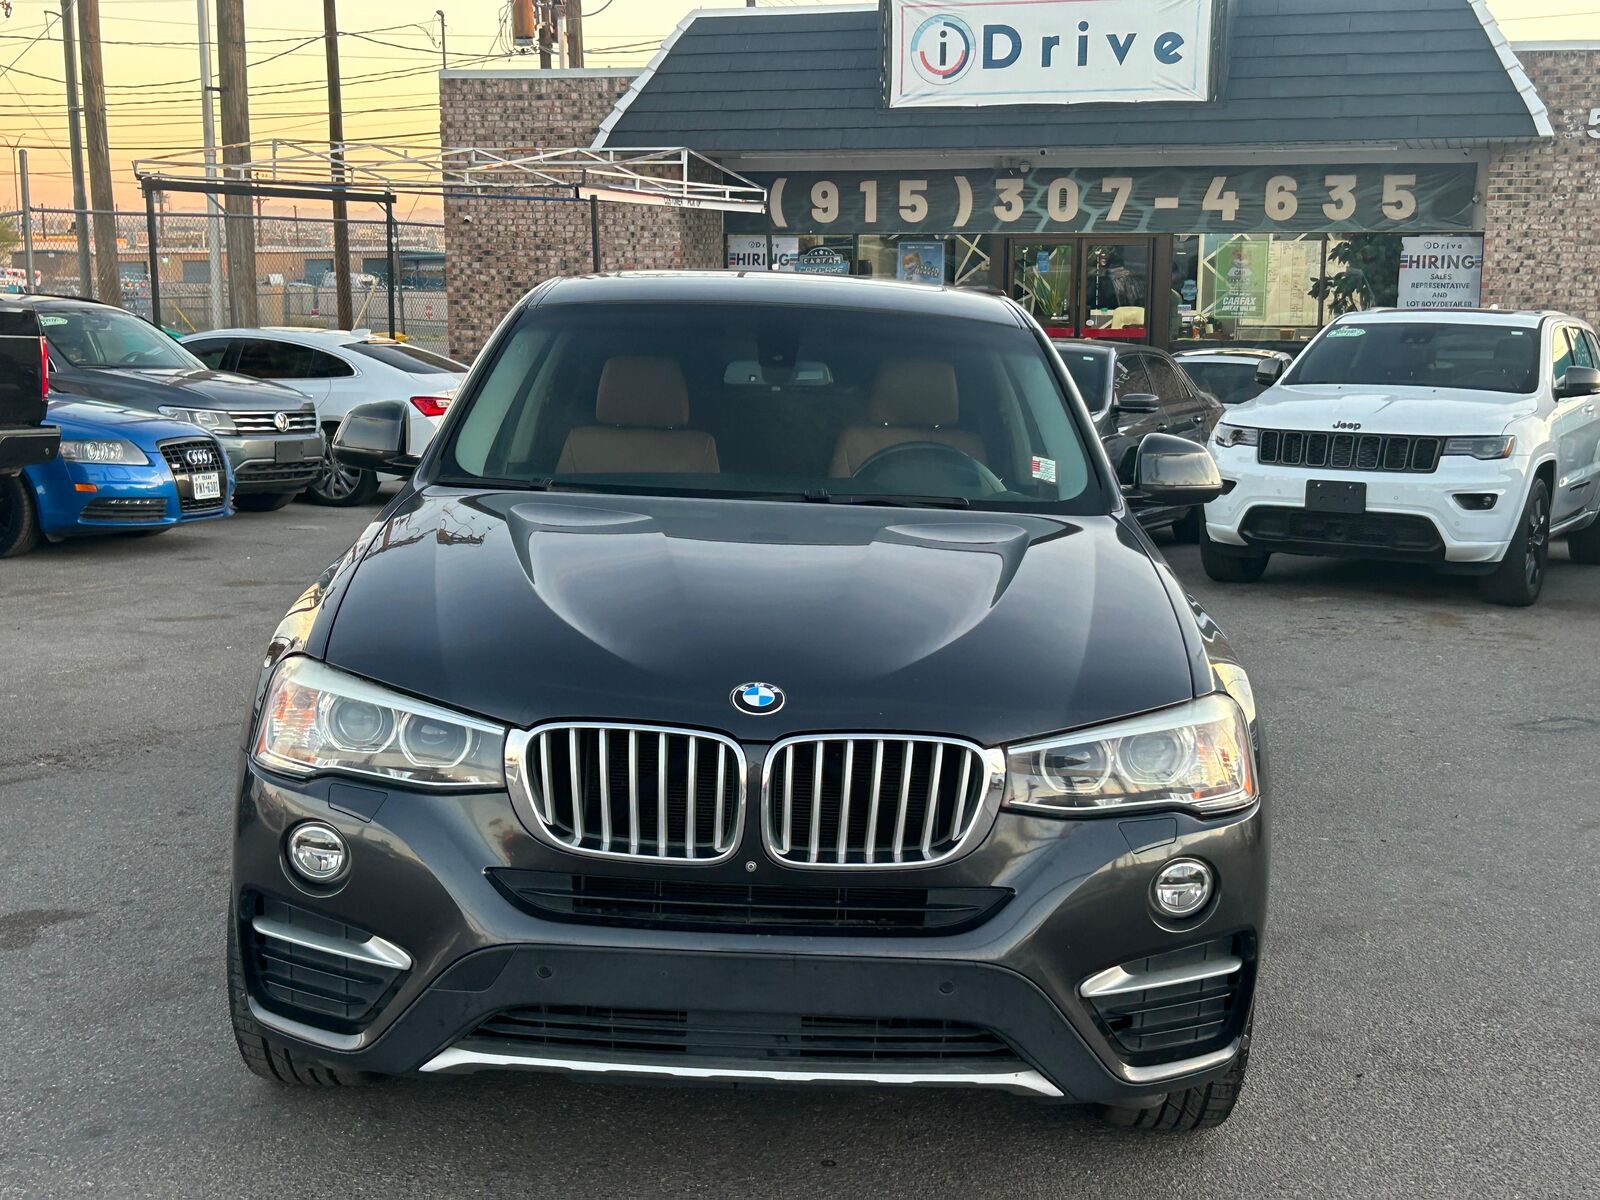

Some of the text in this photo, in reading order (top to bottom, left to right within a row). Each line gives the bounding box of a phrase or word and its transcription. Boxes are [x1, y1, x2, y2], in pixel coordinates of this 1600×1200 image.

[1408, 255, 1475, 269] HIRING
[1222, 296, 1257, 305] CARFAX
[1332, 420, 1362, 431] Jeep
